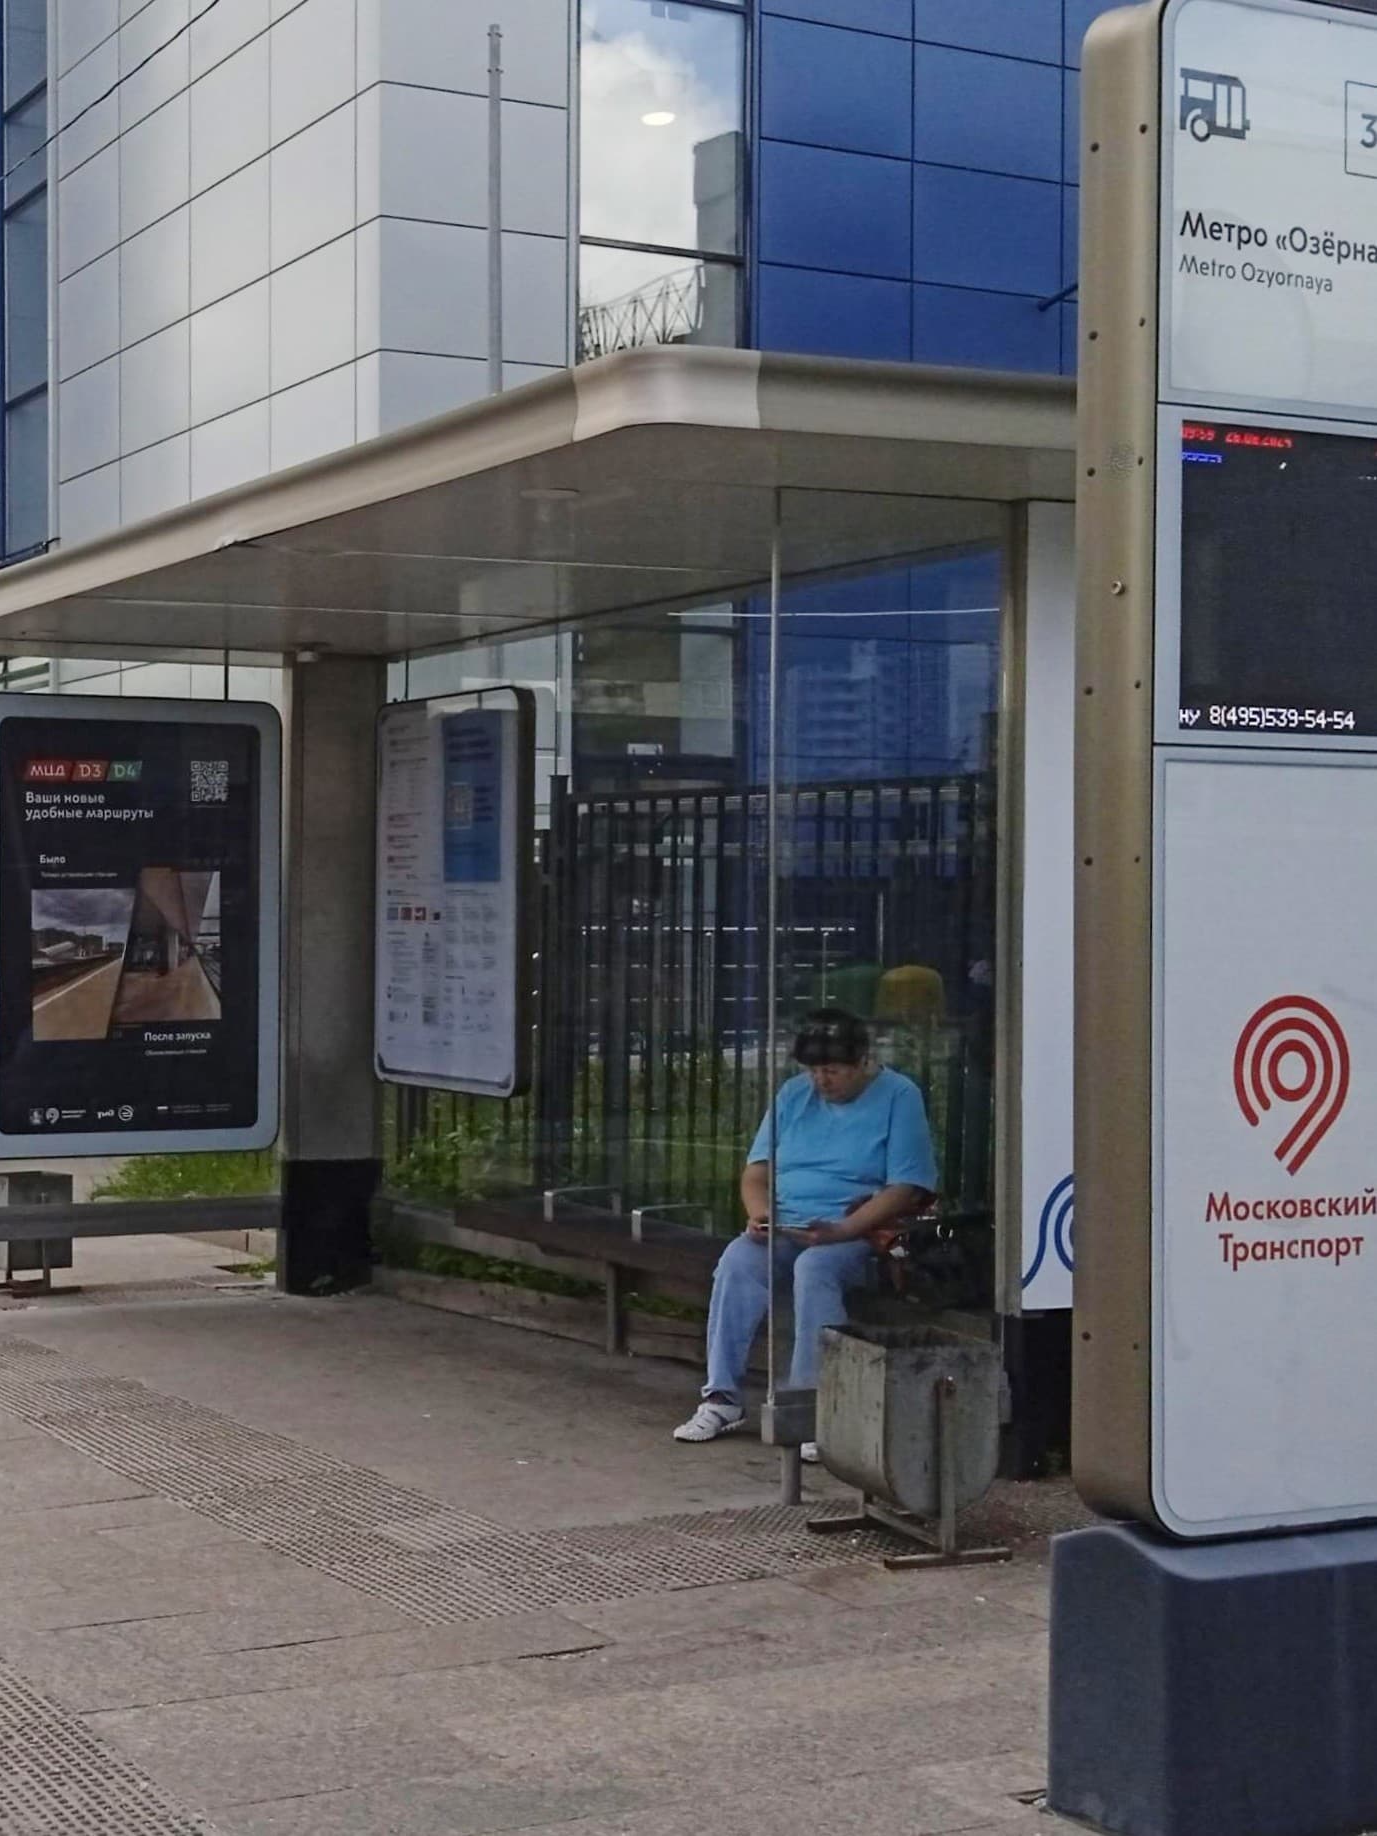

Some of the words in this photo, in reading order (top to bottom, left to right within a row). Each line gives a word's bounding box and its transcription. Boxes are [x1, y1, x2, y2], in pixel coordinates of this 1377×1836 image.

[1180, 210, 1268, 250] Метро
[1178, 253, 1236, 280] Metro
[1240, 262, 1333, 293] Ozyornaya
[1209, 705, 1356, 731] 8(495)539-54-54
[79, 763, 103, 778] D3
[113, 763, 137, 778] D4
[25, 791, 62, 804] Ваши
[63, 793, 106, 804] новые
[25, 806, 84, 822] удобные
[85, 808, 155, 822] маршруты
[39, 854, 66, 864] Было
[144, 1031, 175, 1041] После
[175, 1031, 212, 1042] запуска
[1205, 1186, 1377, 1223] Московский
[1218, 1232, 1365, 1273] Транспорт
